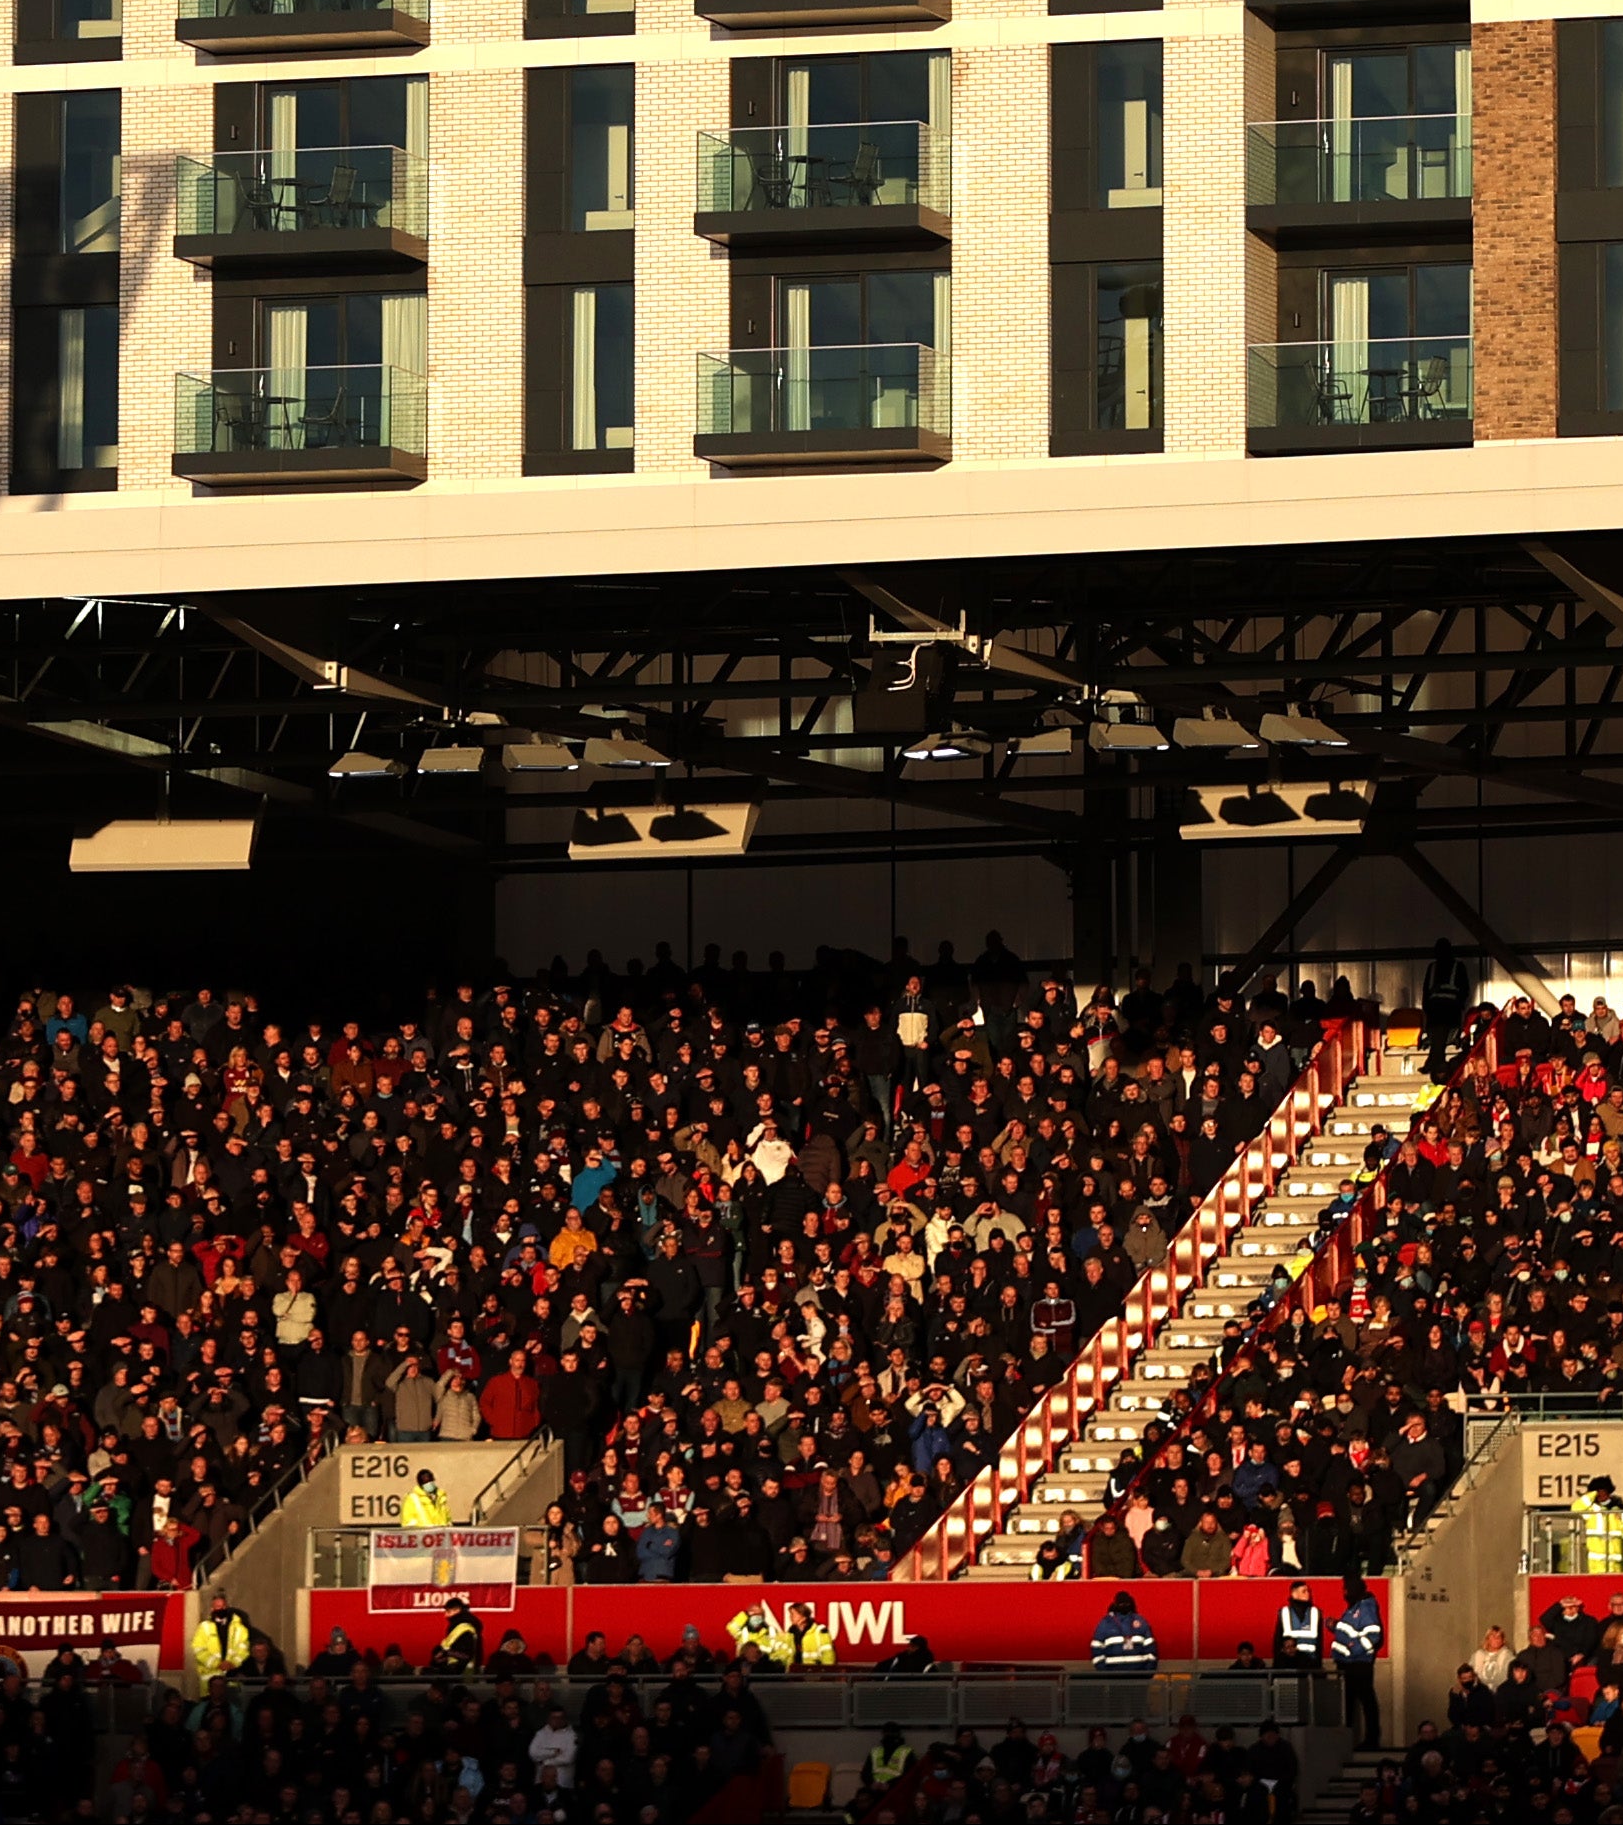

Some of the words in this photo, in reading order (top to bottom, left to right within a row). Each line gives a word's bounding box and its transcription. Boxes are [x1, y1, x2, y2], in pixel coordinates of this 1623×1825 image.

[1539, 1434, 1600, 1456] E215
[351, 1455, 409, 1478] E216
[1539, 1474, 1591, 1498] E115
[351, 1494, 401, 1517] E116
[376, 1534, 418, 1549] ISLE
[422, 1533, 445, 1548] OF
[450, 1532, 515, 1547] WIGHT
[100, 1610, 156, 1635] WIFE
